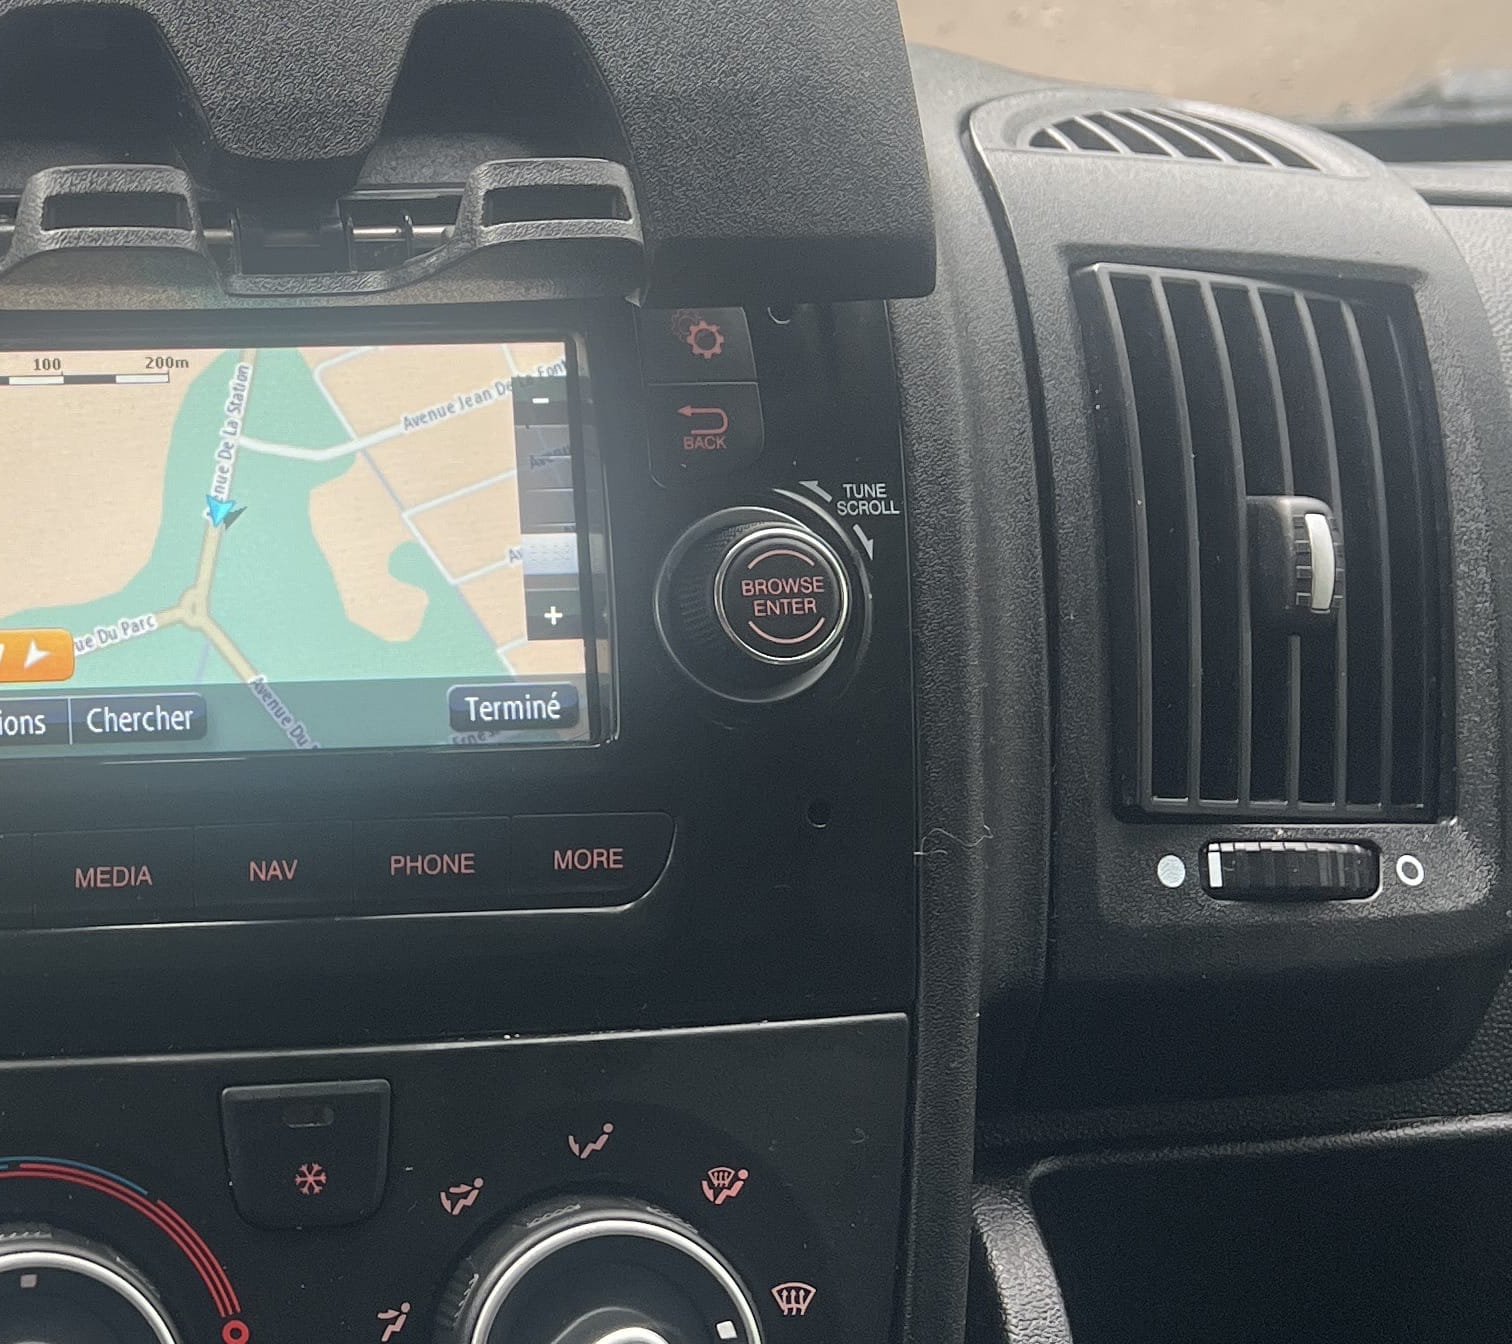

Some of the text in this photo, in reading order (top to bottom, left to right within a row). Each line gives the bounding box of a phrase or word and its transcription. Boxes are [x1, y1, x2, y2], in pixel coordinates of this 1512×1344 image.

[33, 358, 61, 370] 100
[145, 356, 189, 369] 200m
[218, 441, 234, 460] De
[226, 364, 250, 414] Station
[402, 399, 456, 431] Avenue
[458, 387, 492, 411] Jean
[683, 436, 728, 449] BACK
[843, 483, 888, 499] TUNE
[837, 500, 900, 516] SCROLL
[741, 576, 825, 597] BROWSE
[753, 599, 817, 617] ENTER
[96, 628, 119, 644] Du
[121, 615, 156, 636] Parc
[464, 691, 561, 721] Terminé
[86, 705, 194, 733] Chercher
[390, 852, 476, 876] PHONE
[553, 847, 624, 870] MORE
[74, 865, 153, 889] MEDIA
[248, 859, 298, 882] NAV
